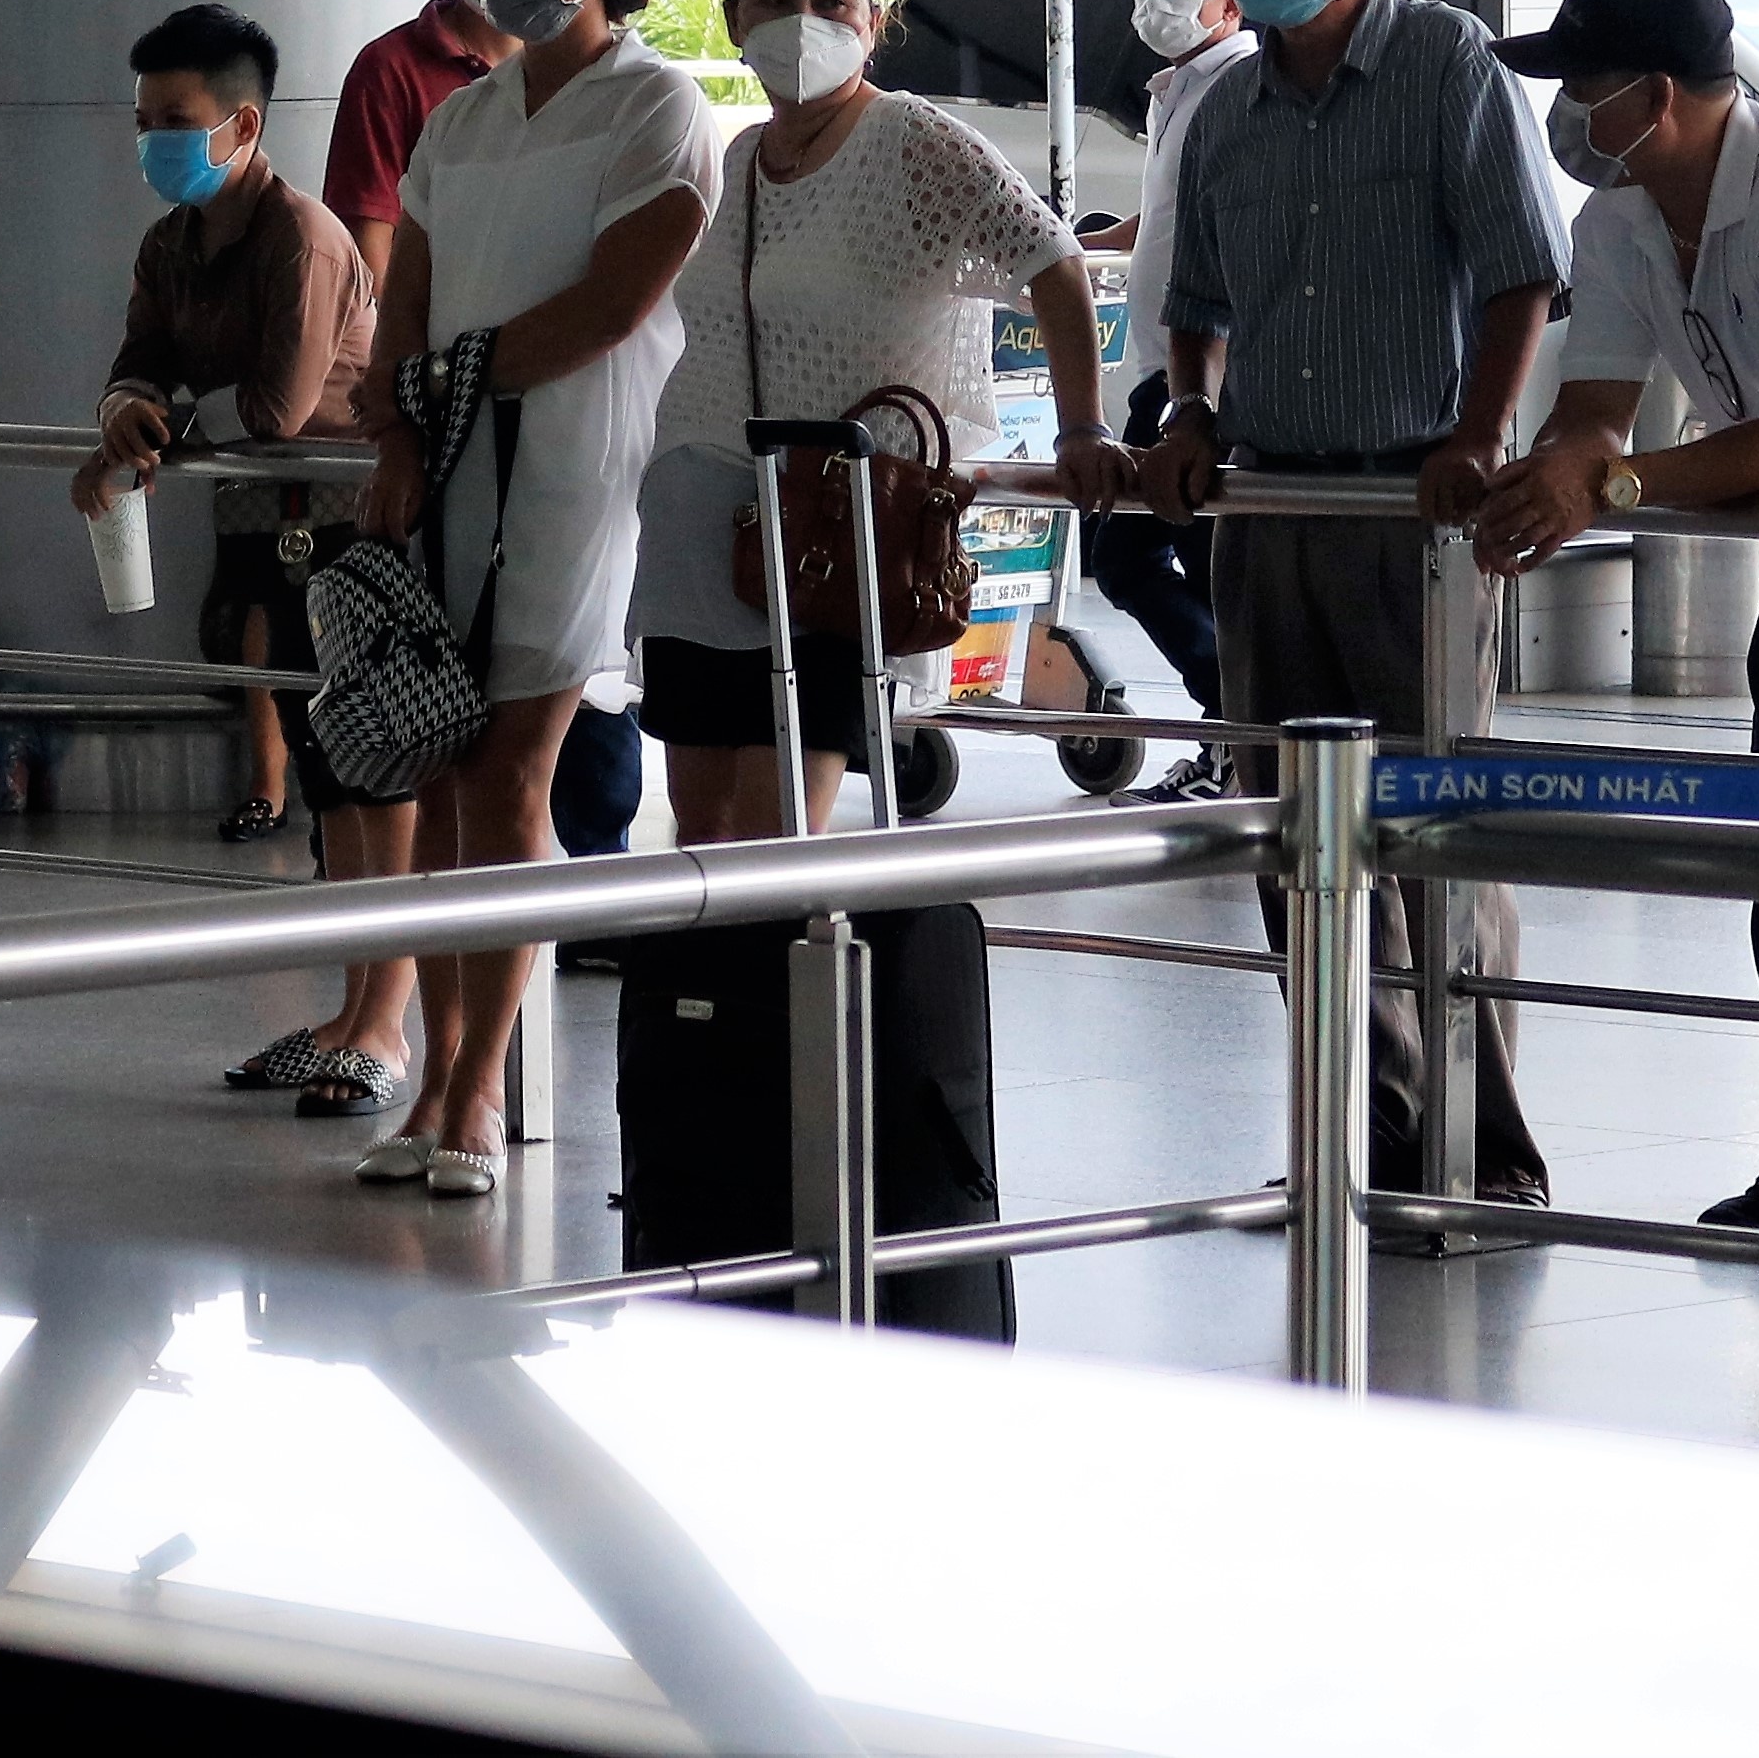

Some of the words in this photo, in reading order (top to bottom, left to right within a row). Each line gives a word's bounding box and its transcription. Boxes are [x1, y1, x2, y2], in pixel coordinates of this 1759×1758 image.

[1413, 768, 1488, 802] TÂN
[1502, 774, 1584, 802] SƠN
[1599, 768, 1703, 804] NHẤT
